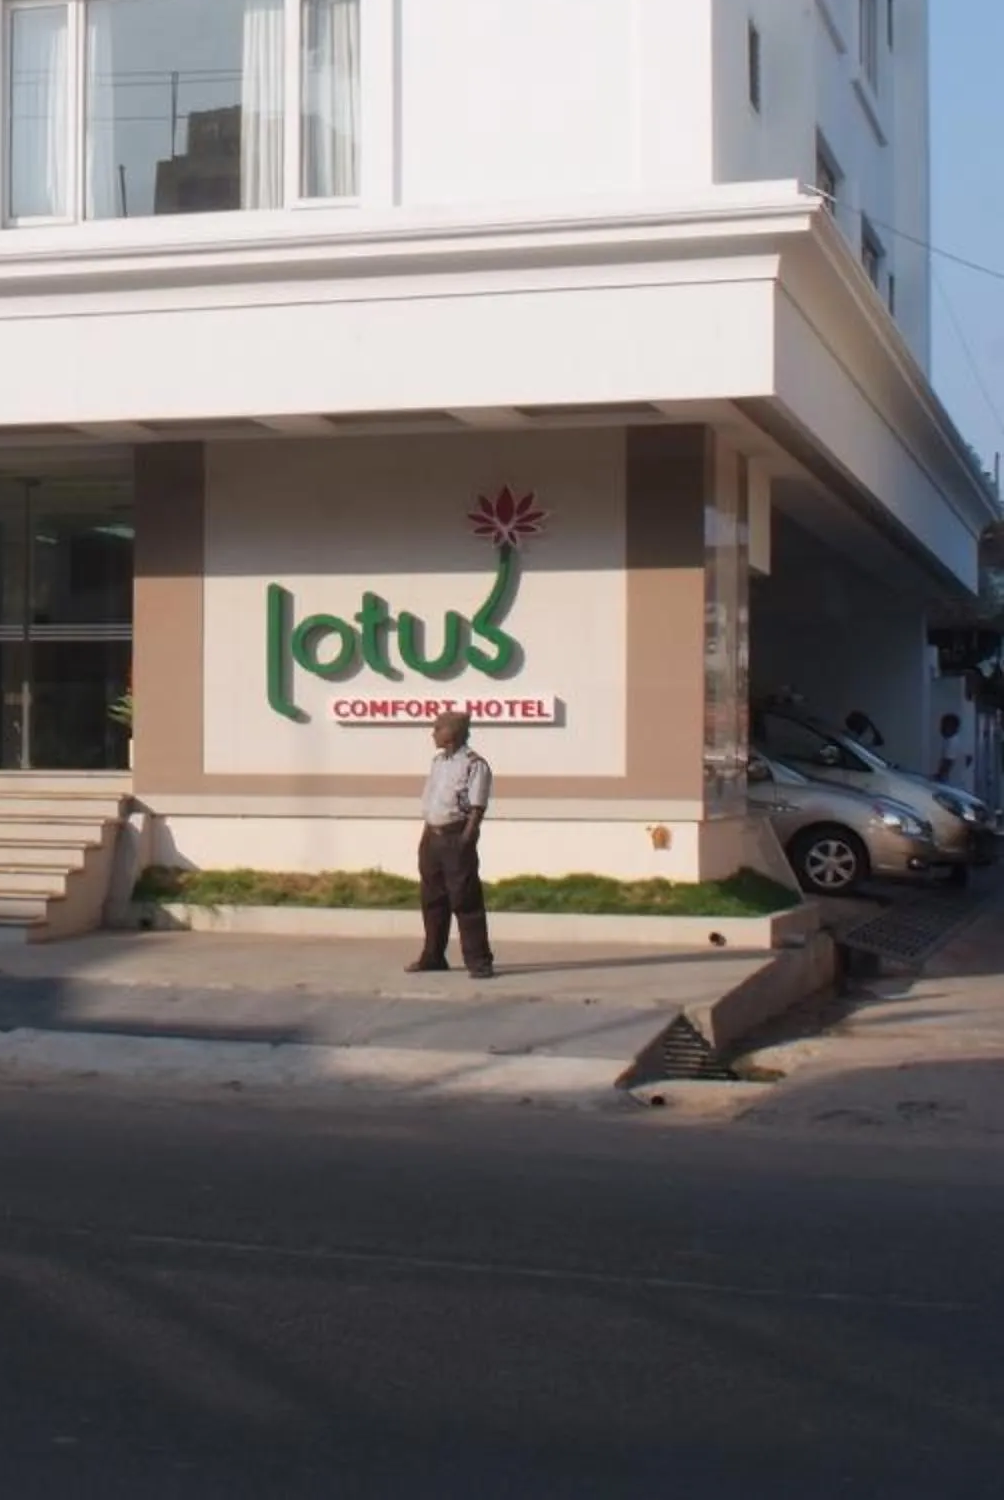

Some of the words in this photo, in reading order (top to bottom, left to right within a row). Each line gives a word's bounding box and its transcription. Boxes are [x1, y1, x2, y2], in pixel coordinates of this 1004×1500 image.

[267, 543, 518, 723] lotus
[333, 699, 458, 718] COMFORT
[467, 699, 552, 718] HOTEL
